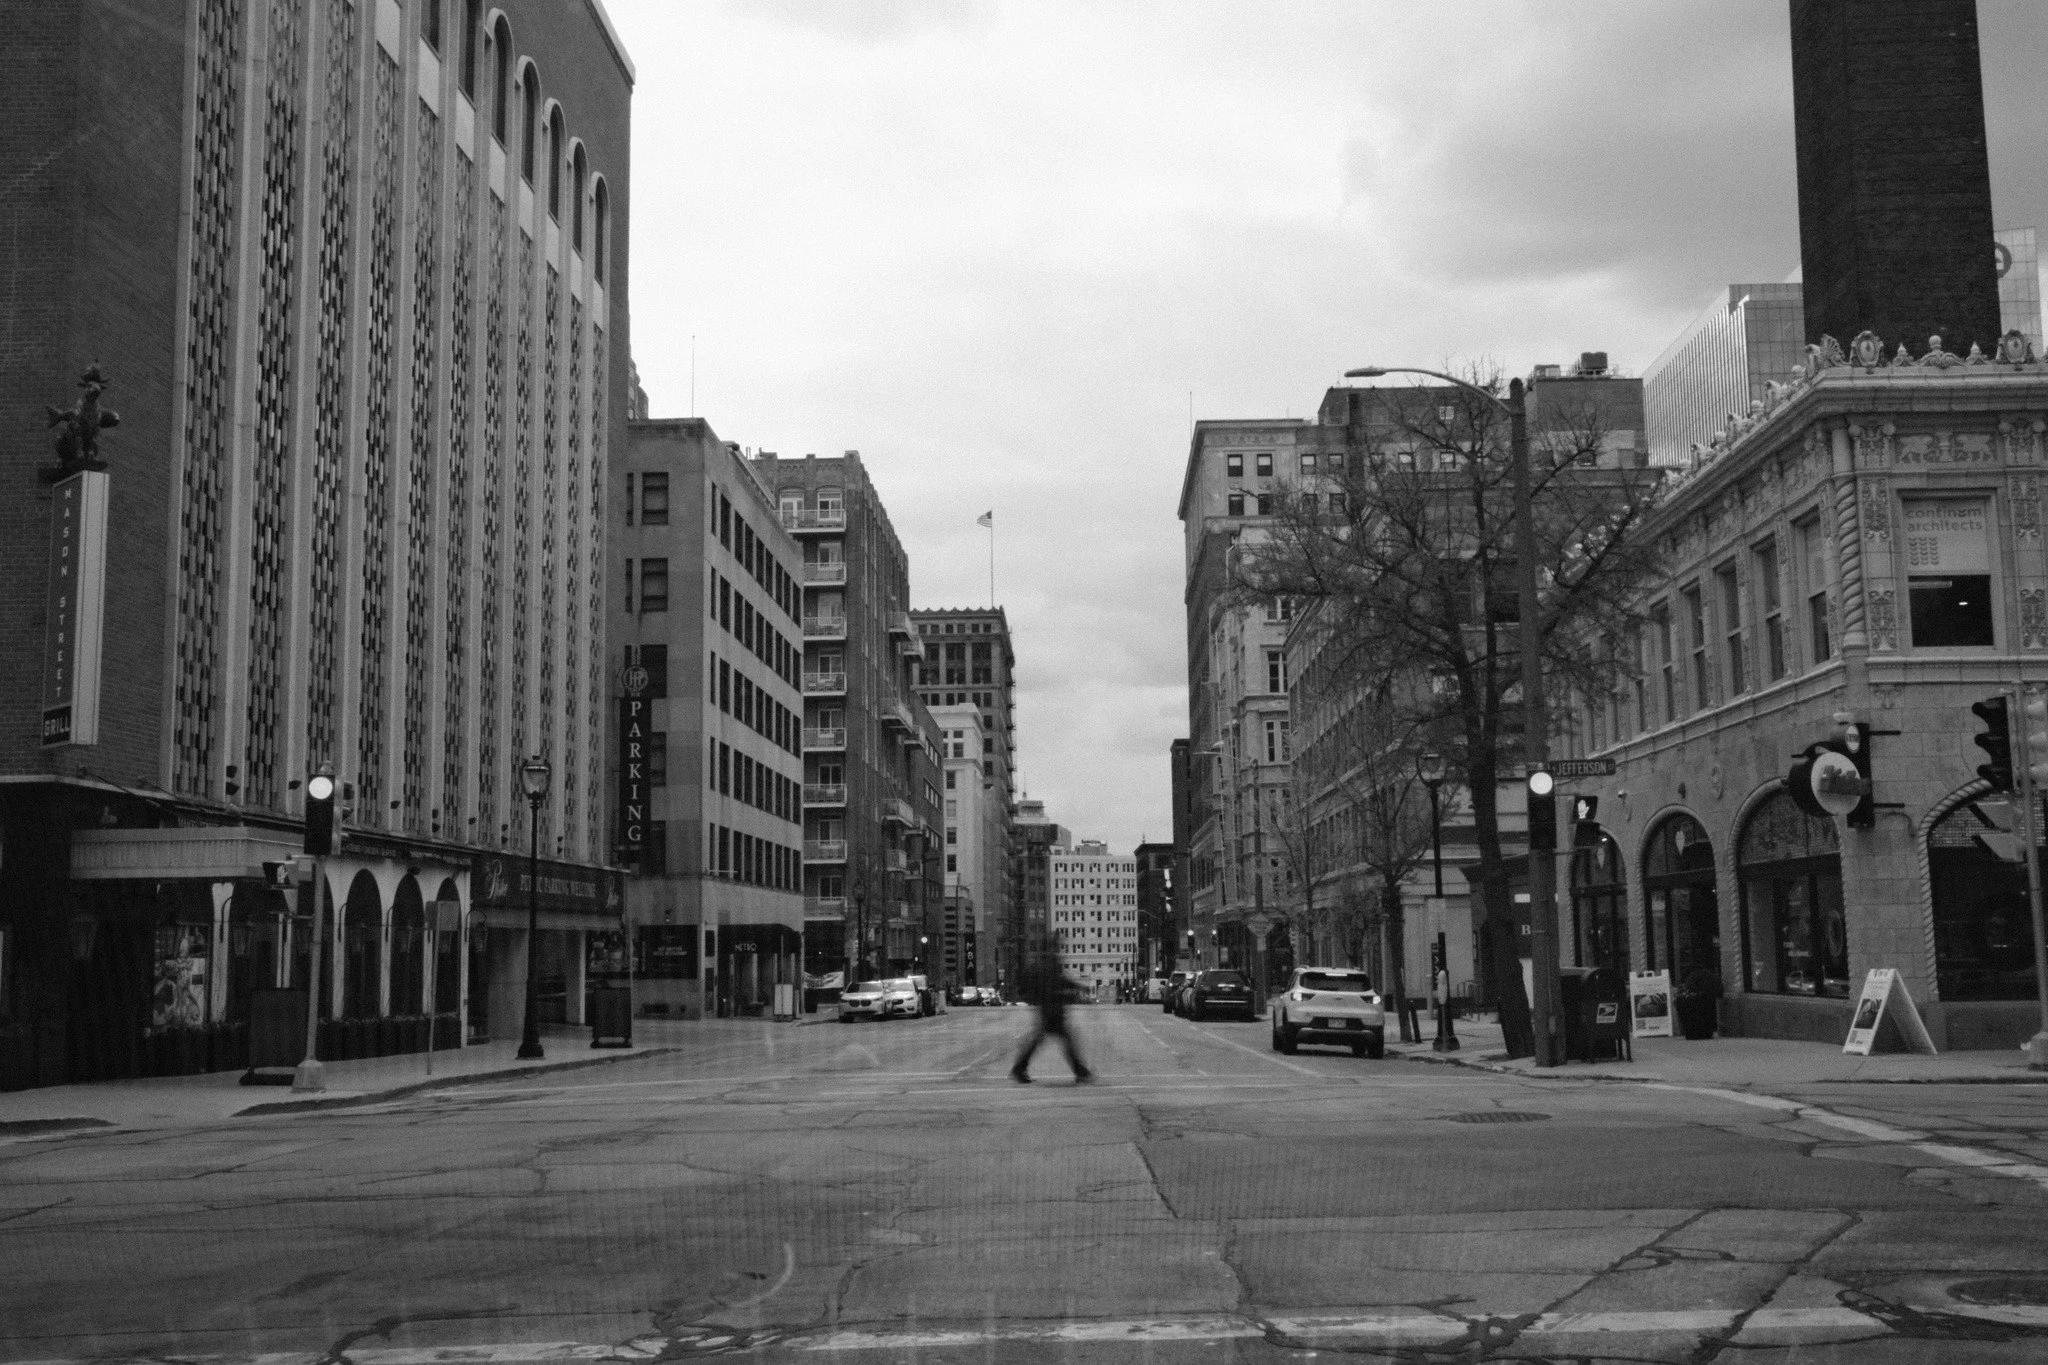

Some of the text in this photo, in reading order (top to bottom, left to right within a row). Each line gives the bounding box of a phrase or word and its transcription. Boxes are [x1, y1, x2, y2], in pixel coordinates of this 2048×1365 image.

[1907, 519, 1983, 532] architects
[56, 488, 72, 698] MASON STREET
[44, 716, 70, 736] GRILL
[627, 700, 643, 842] PARKING
[1556, 760, 1607, 776] JEFFERSON
[735, 942, 758, 952] METRO
